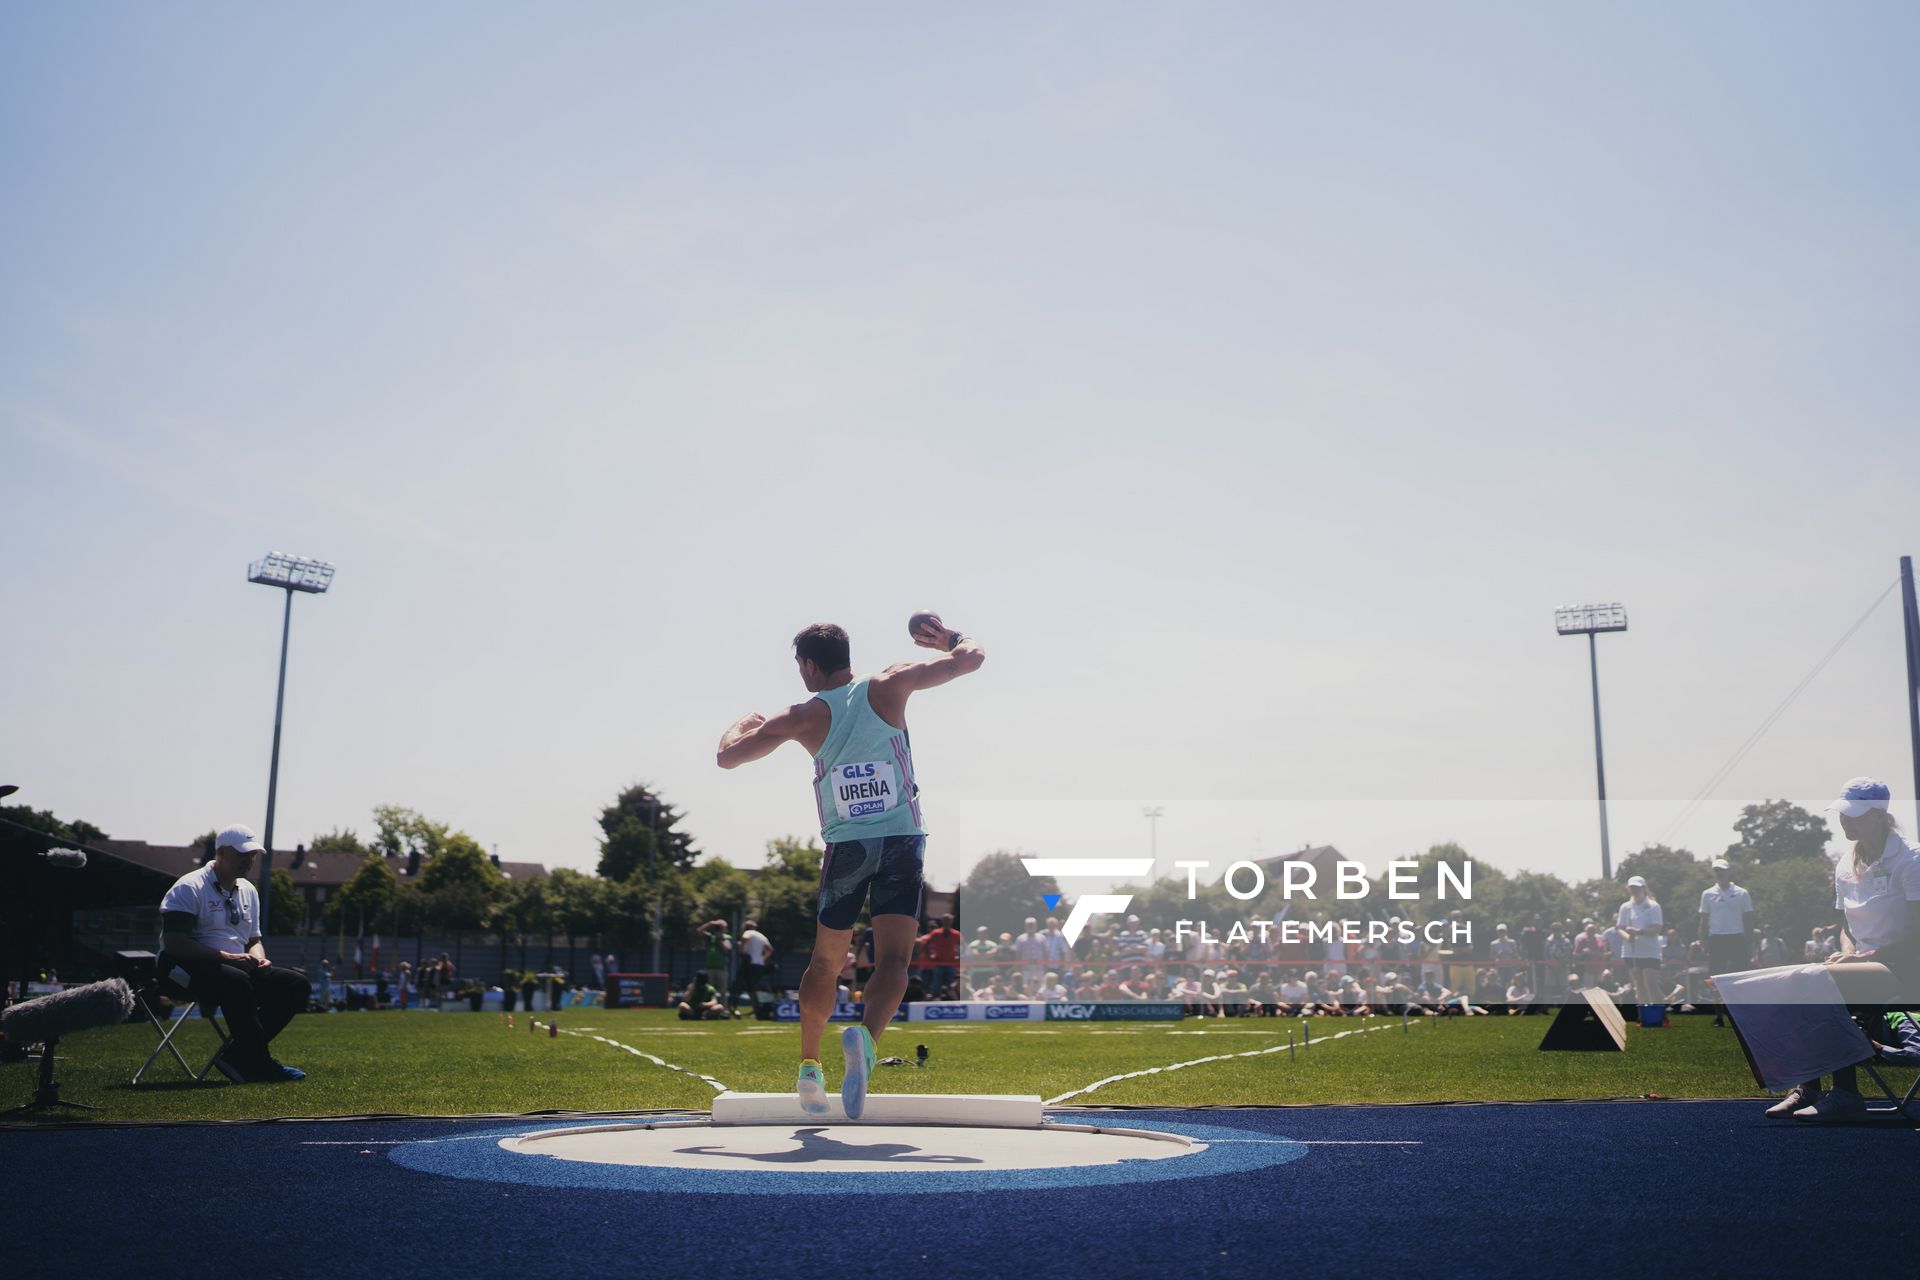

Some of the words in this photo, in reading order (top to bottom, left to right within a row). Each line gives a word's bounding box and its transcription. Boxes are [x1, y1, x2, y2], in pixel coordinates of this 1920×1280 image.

[843, 763, 875, 779] GLS
[840, 777, 891, 801] UREÑA
[1049, 1004, 1096, 1018] WGV
